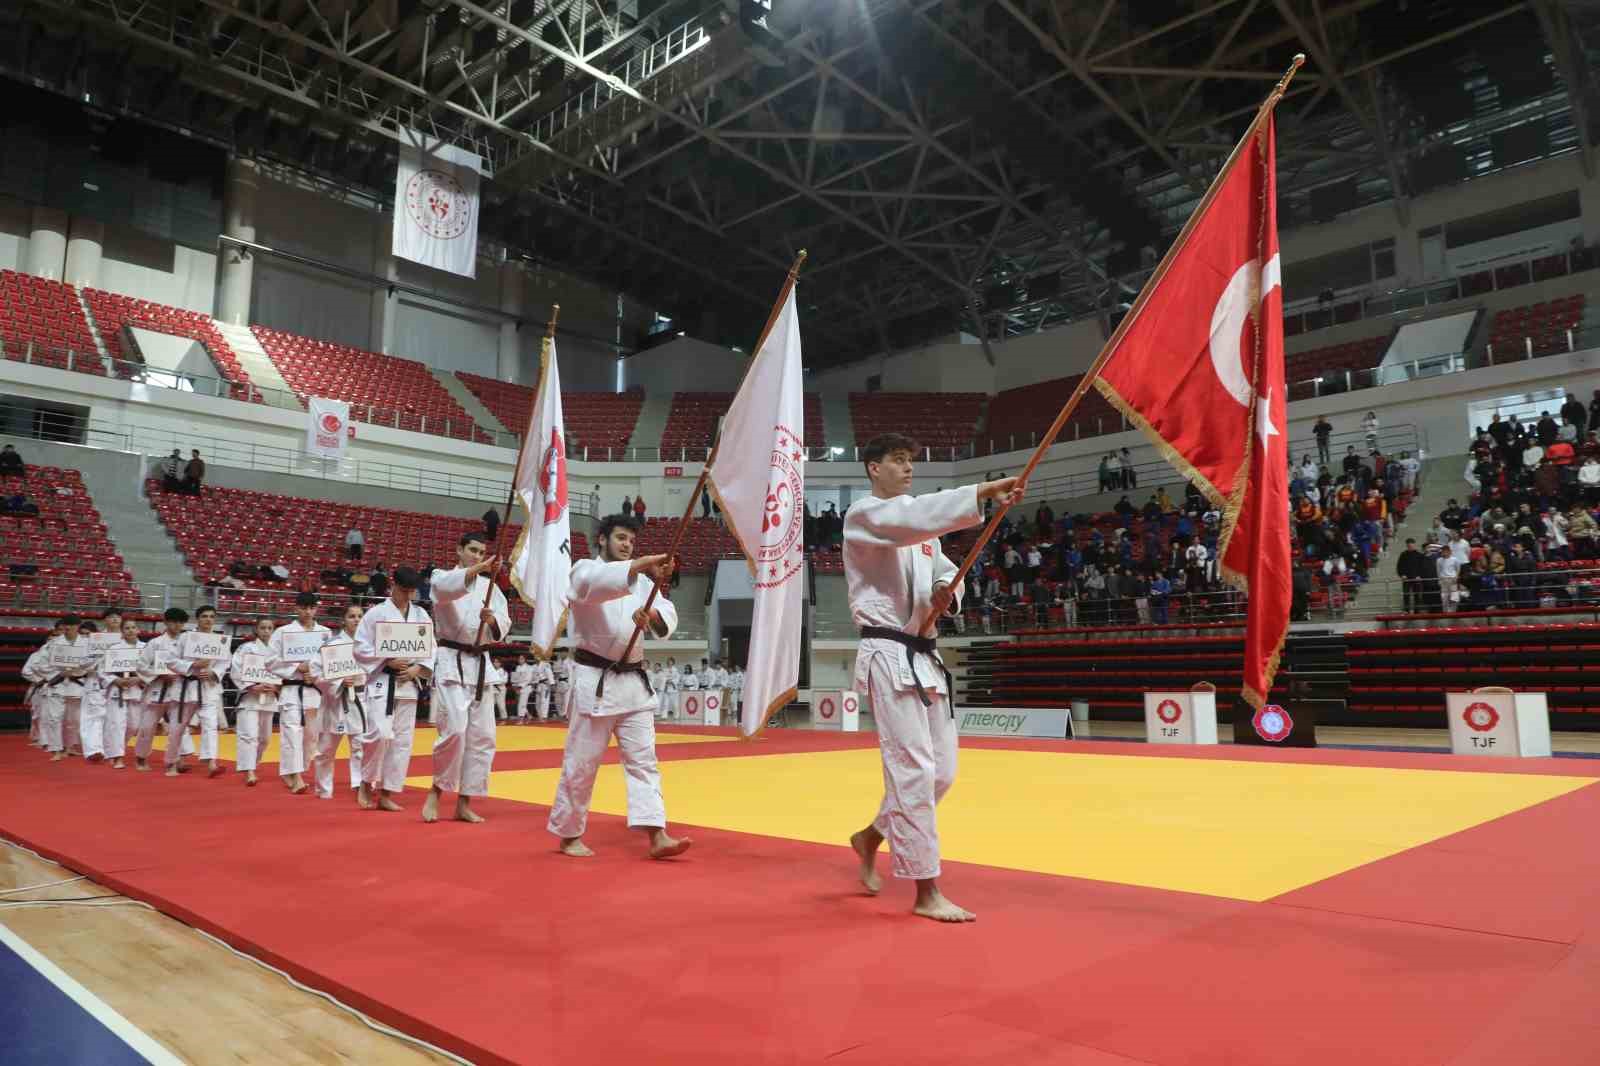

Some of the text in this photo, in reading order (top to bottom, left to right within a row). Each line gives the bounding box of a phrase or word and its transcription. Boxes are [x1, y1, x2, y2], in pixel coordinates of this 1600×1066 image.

[380, 639, 426, 652] ADANA
[961, 711, 1027, 732] intercity
[1161, 728, 1180, 737] TJF
[1471, 736, 1497, 748] TJF
